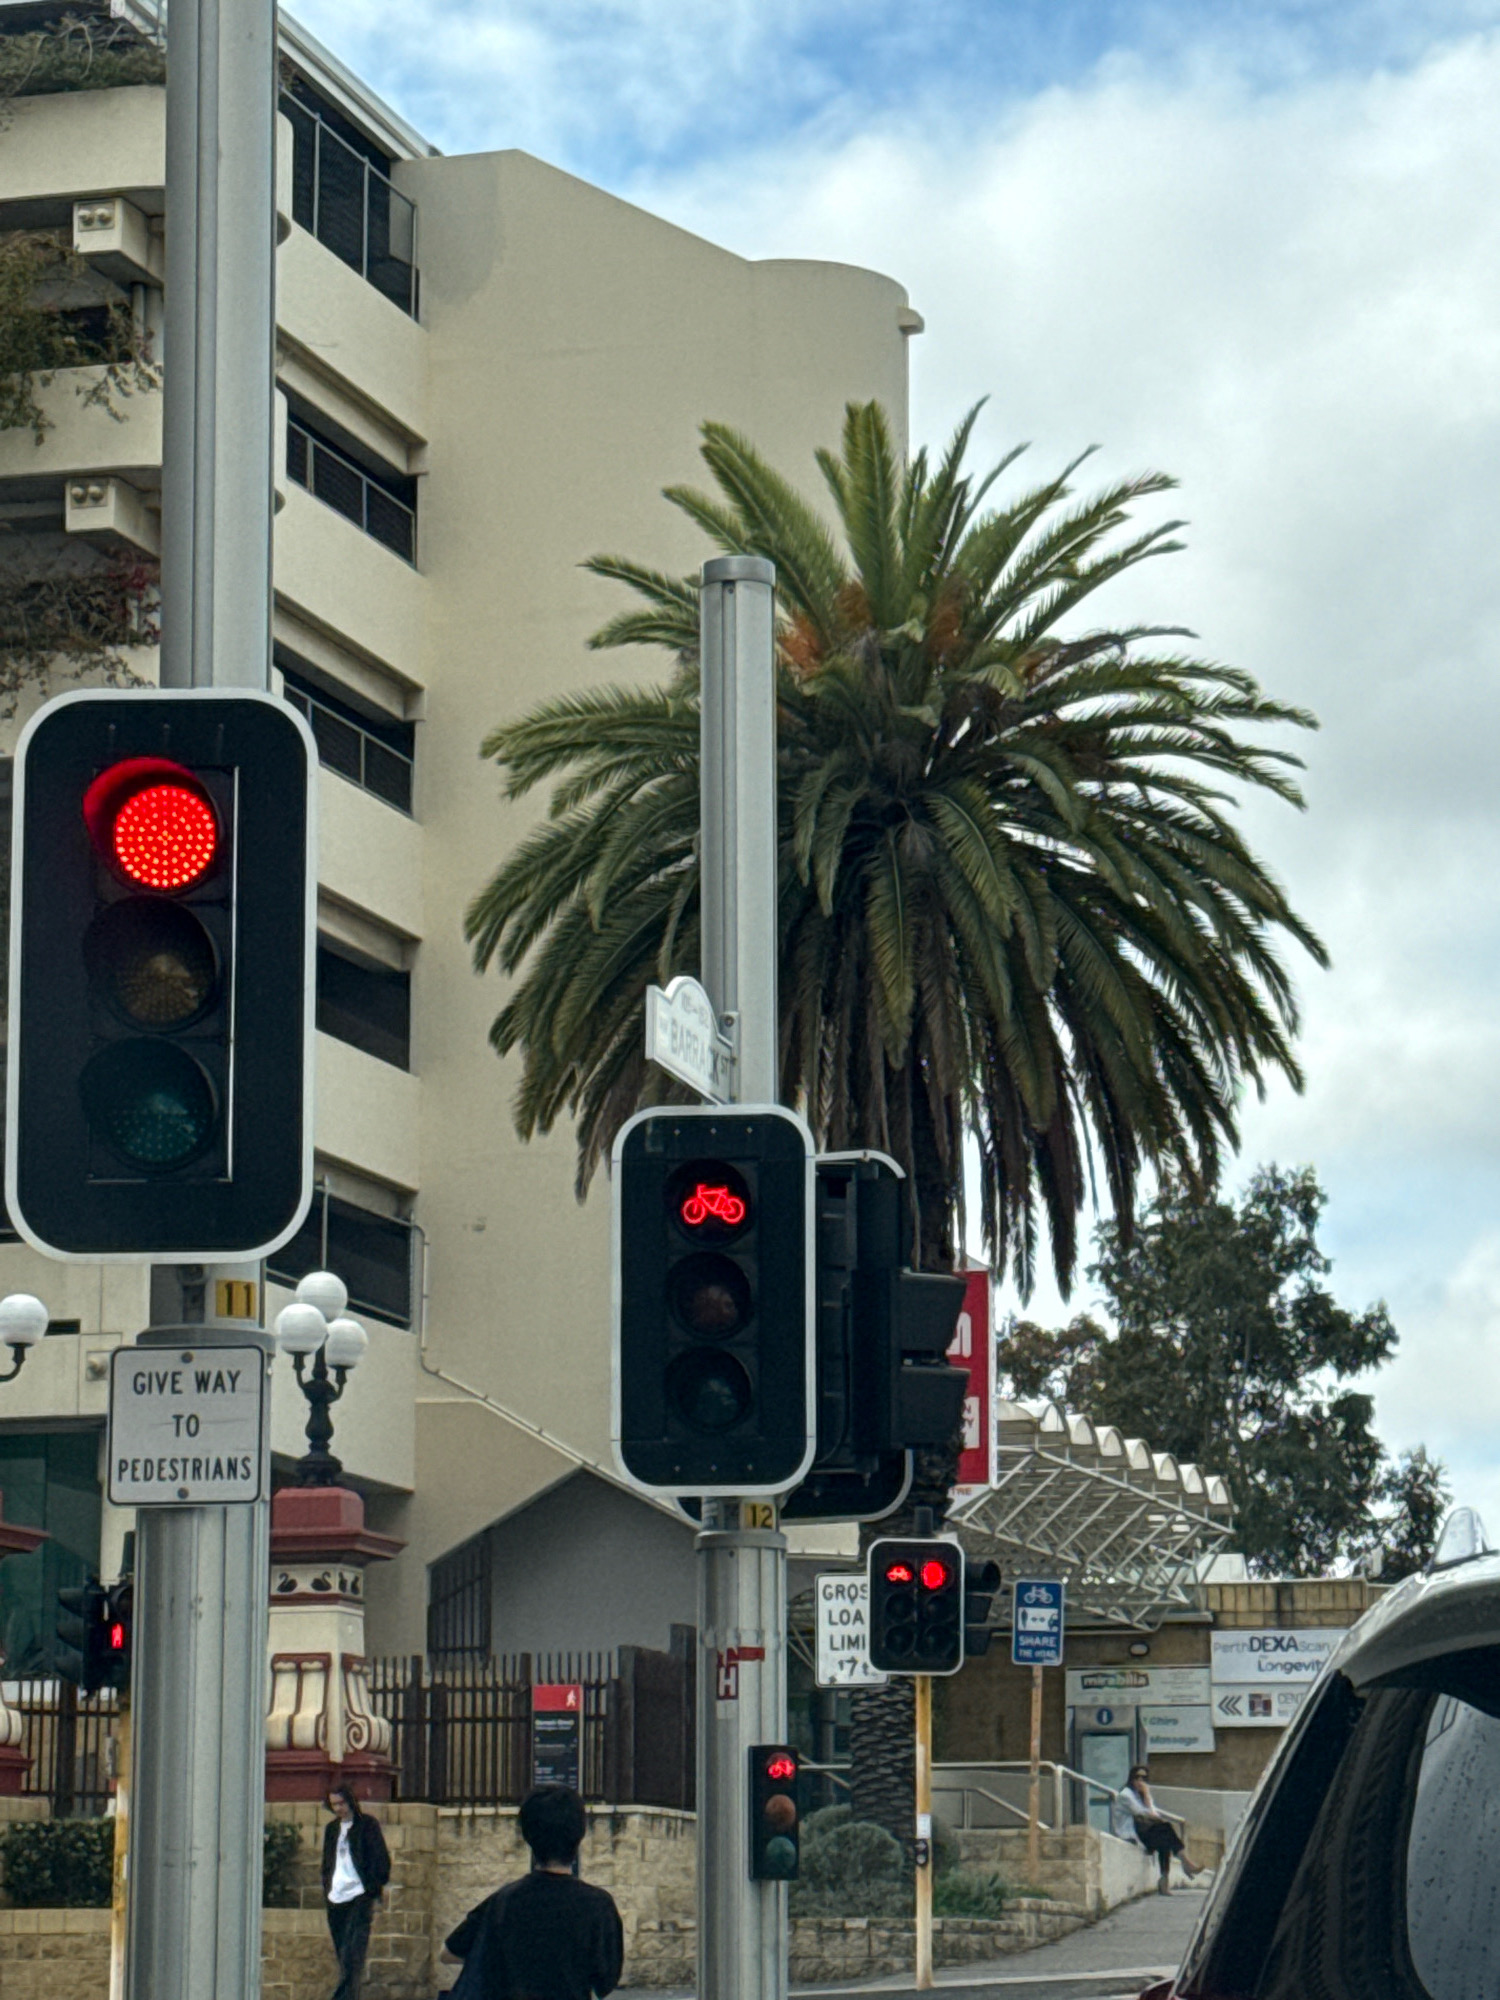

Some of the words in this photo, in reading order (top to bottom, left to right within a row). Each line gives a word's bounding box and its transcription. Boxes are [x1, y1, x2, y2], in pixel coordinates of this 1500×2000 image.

[225, 1282, 251, 1316] 11
[133, 1371, 183, 1395] GIVE
[195, 1369, 241, 1394] WAY
[172, 1414, 200, 1438] TO
[118, 1456, 251, 1482] PEDESTRIANS
[751, 1506, 773, 1528] 12
[822, 1583, 868, 1601] GROS
[828, 1609, 865, 1626] LOA
[830, 1634, 866, 1651] LIMI
[1019, 1635, 1057, 1647] SHARE
[1249, 1635, 1299, 1652] DEXA
